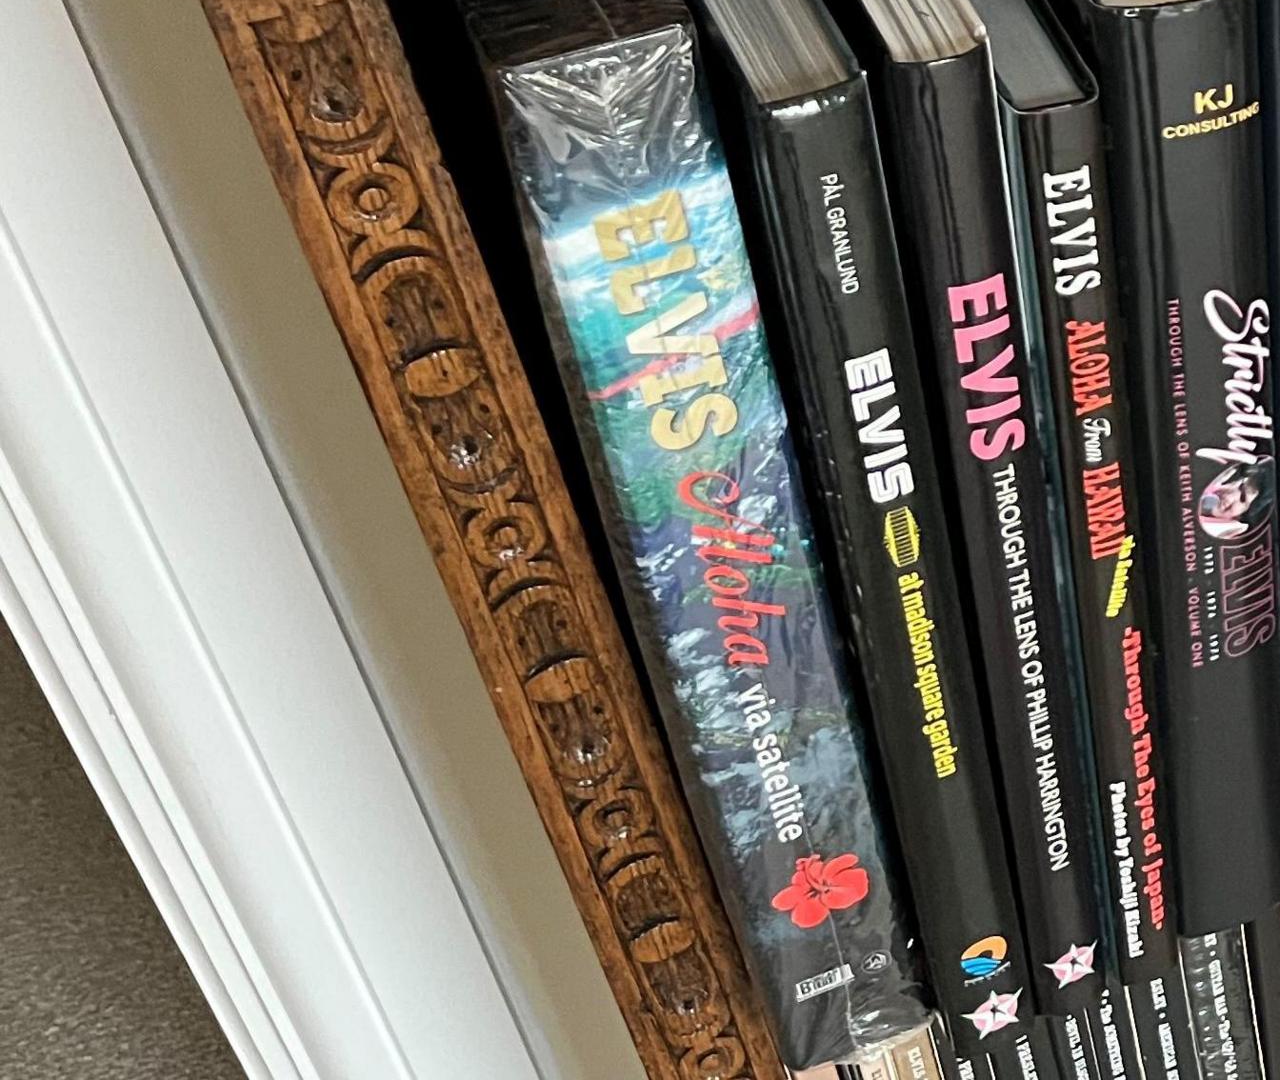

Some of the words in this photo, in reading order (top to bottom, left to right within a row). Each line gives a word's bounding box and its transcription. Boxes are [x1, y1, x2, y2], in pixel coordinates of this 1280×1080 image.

[1162, 101, 1260, 140] CONSULTING
[1193, 83, 1235, 114] KJ
[820, 173, 840, 207] PÅL
[826, 207, 860, 294] GRANLUND
[1041, 165, 1102, 297] ELVIS
[594, 189, 739, 451] ELVIS
[947, 273, 1026, 461] ELVIS
[1195, 289, 1275, 466] Strictly
[844, 347, 915, 504] ELVIS
[992, 462, 1028, 569] THROUGH
[677, 470, 788, 668] Aloha
[898, 571, 925, 593] at
[1008, 568, 1033, 611] THE
[1220, 523, 1276, 658] ELVIS
[902, 590, 935, 666] madison
[1013, 610, 1040, 660] LENS
[737, 682, 771, 726] via
[914, 663, 945, 723] square
[1021, 660, 1045, 687] OF
[922, 719, 958, 779] garden
[1024, 687, 1054, 752] PHILLIP
[752, 730, 805, 843] satellite
[1035, 753, 1070, 872] HARRINGTON
